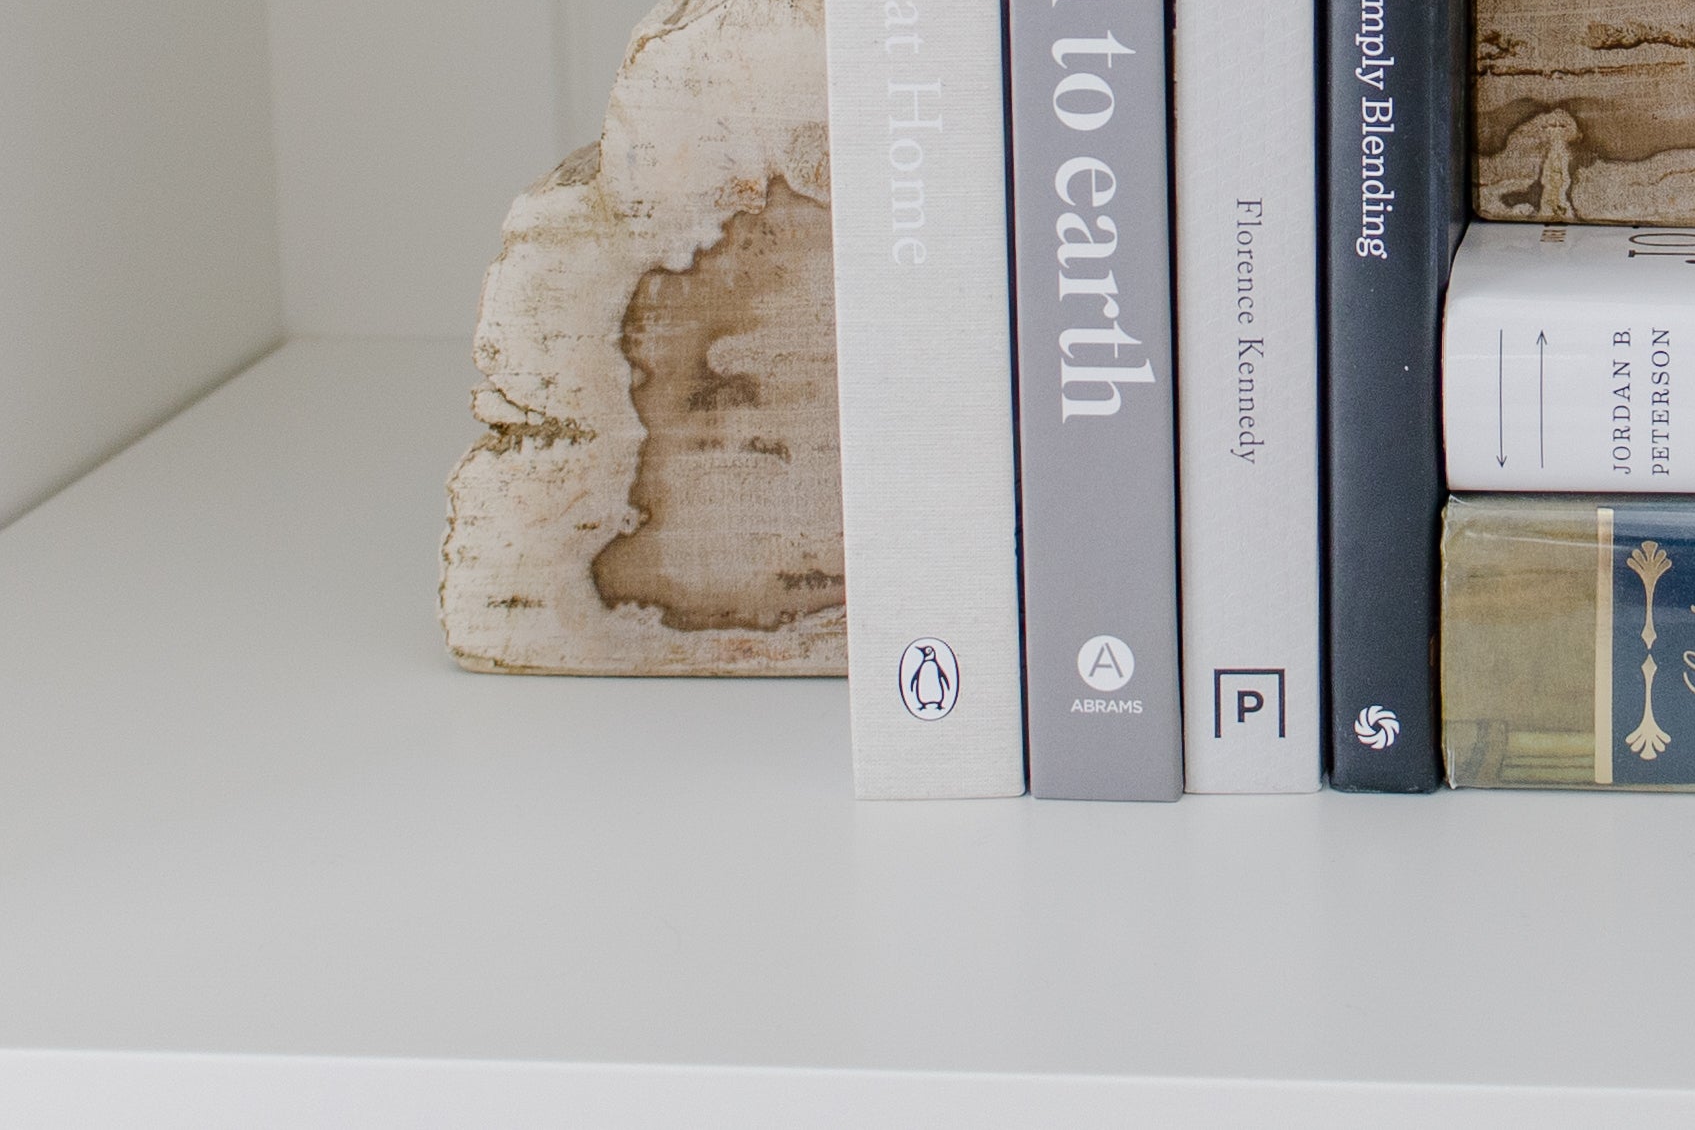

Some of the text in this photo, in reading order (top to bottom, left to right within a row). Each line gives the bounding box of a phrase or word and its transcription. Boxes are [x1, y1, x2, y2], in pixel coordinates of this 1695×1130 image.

[1051, 29, 1137, 131] to
[887, 78, 943, 266] Home
[1355, 97, 1395, 260] Blending
[1054, 156, 1157, 424] earth
[1230, 197, 1265, 465] Florence Kennedy
[1612, 327, 1632, 475] JORDAN B.
[1651, 326, 1670, 476] PETERSON
[1070, 698, 1144, 715] ABRAMS
[1236, 690, 1265, 723] P
